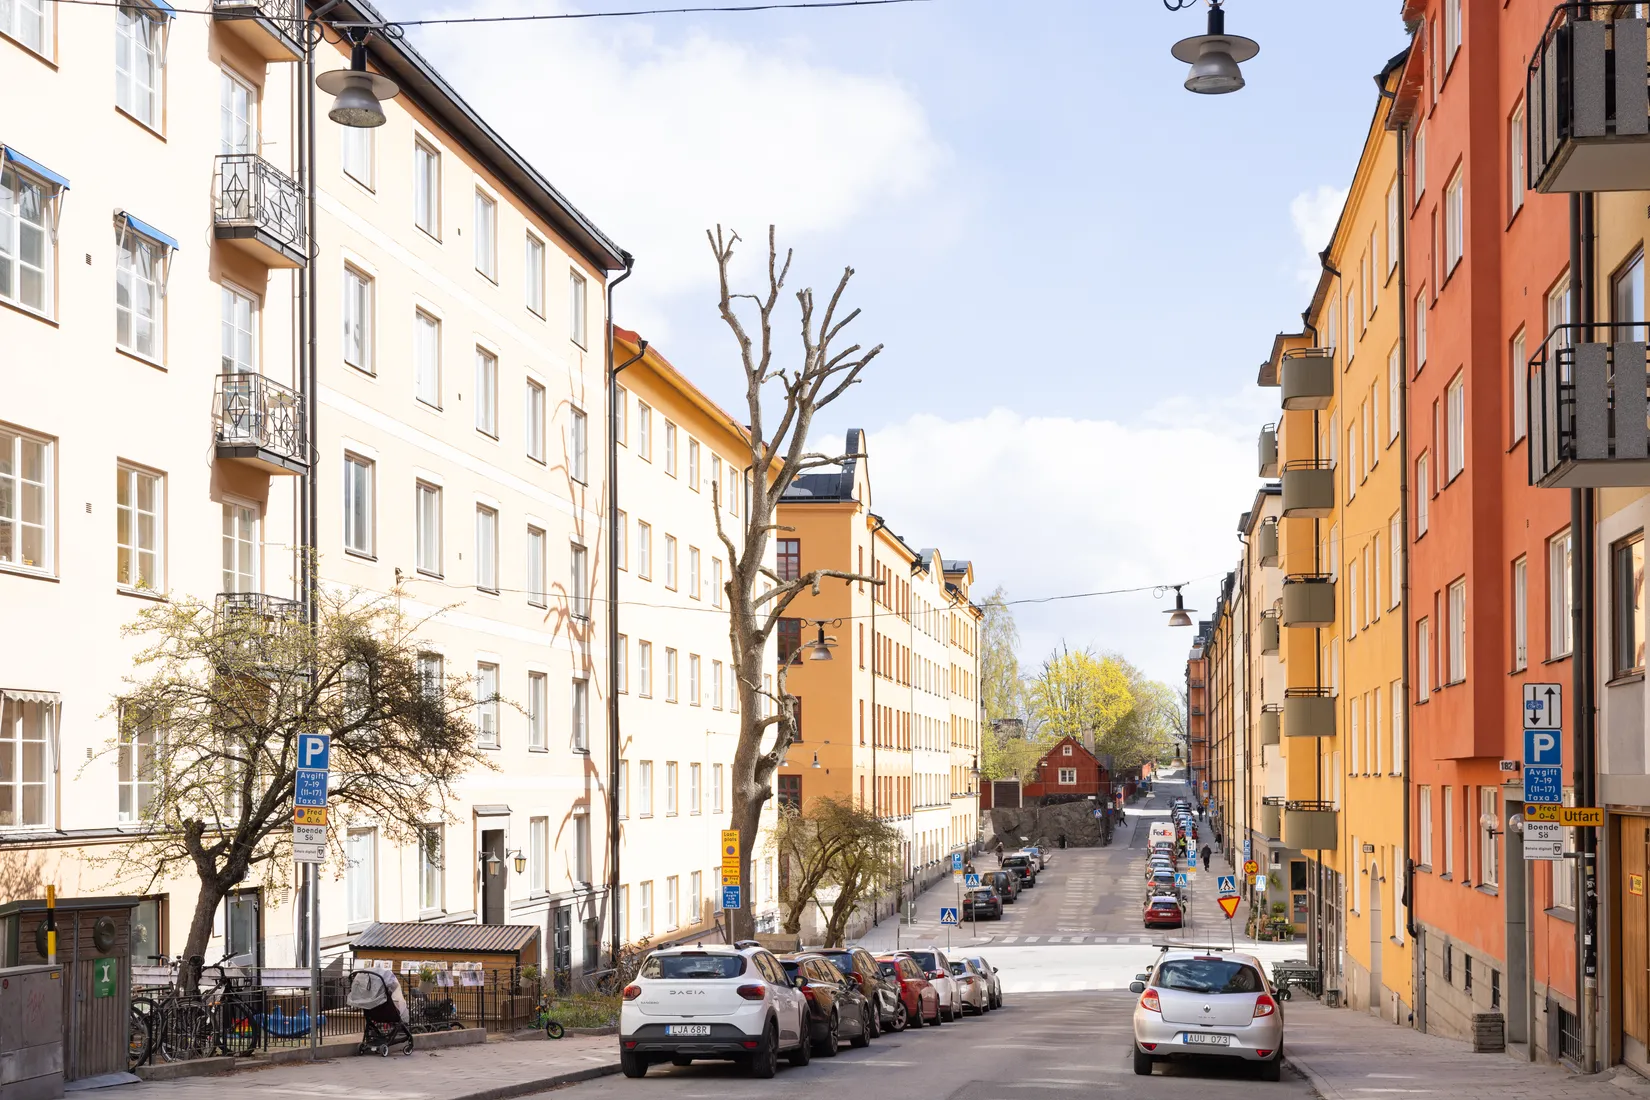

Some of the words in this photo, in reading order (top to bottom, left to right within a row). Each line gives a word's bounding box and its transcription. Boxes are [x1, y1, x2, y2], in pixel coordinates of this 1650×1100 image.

[306, 738, 324, 766] P
[1534, 734, 1554, 762] P
[1501, 762, 1512, 770] 182
[300, 772, 324, 780] Avgift
[1530, 768, 1557, 777] Avgift
[1564, 811, 1600, 822] Utfart
[672, 1026, 688, 1034] LJA
[691, 1026, 707, 1034] 68R
